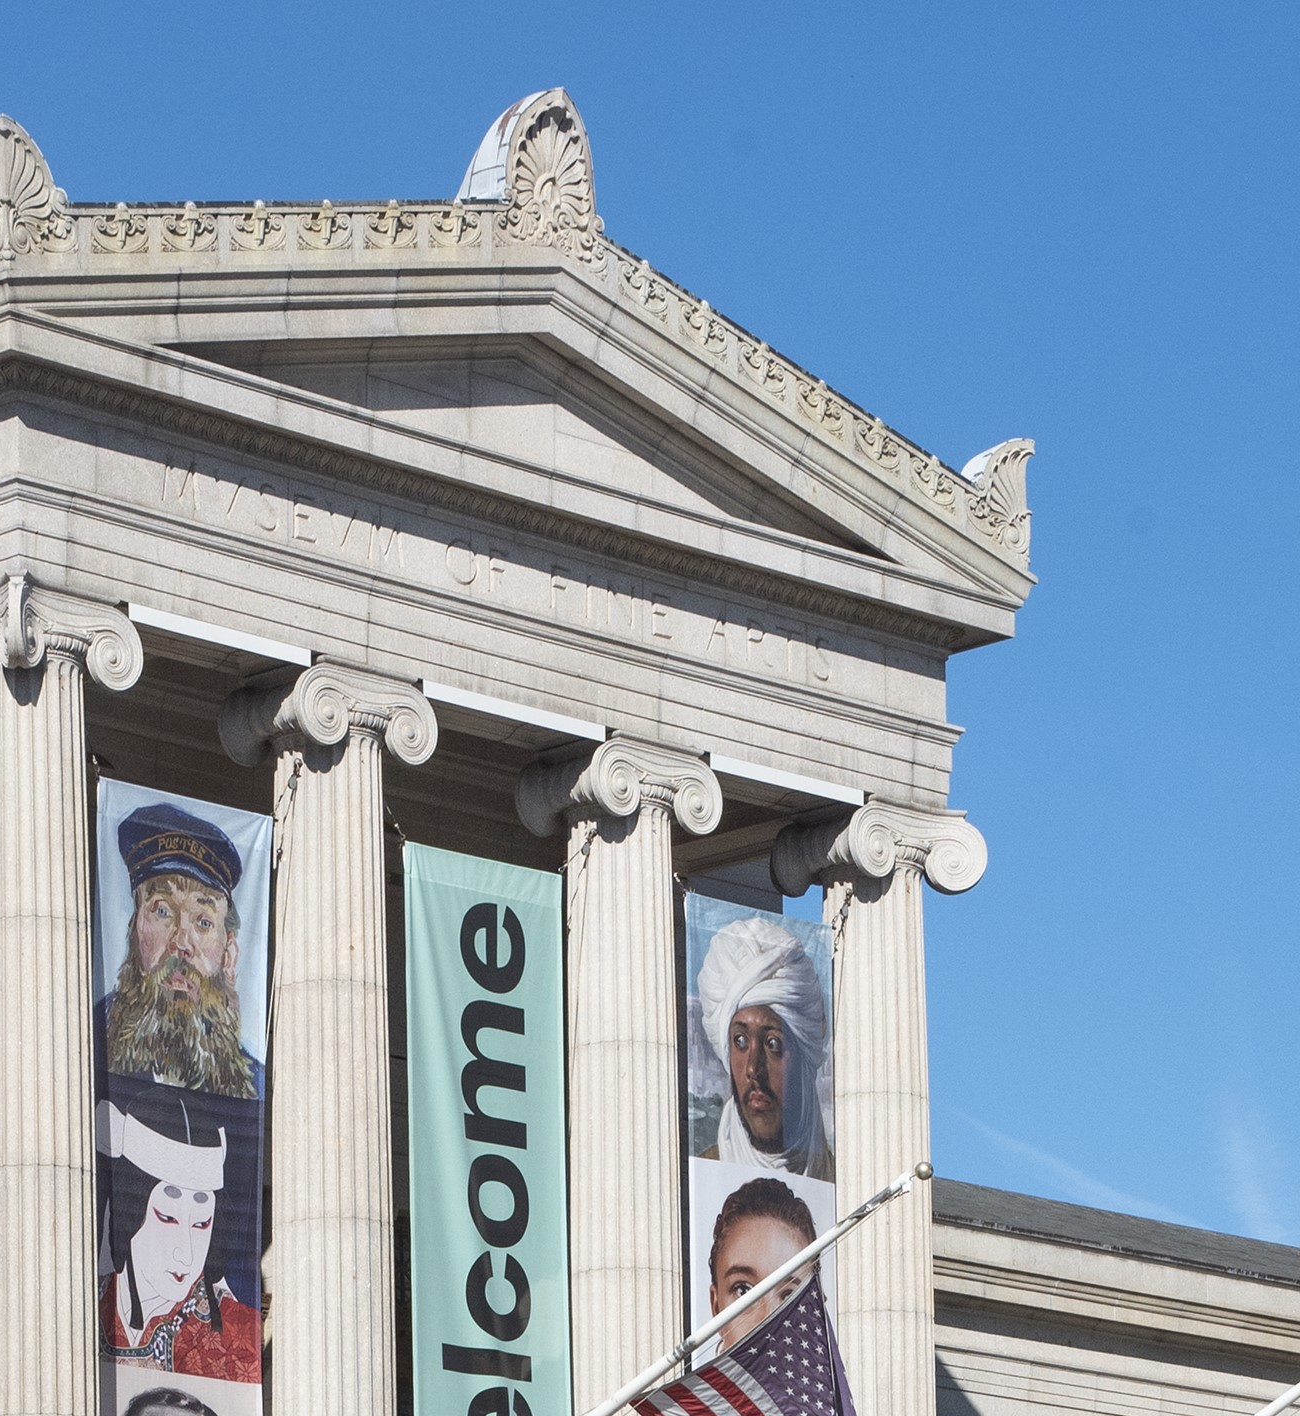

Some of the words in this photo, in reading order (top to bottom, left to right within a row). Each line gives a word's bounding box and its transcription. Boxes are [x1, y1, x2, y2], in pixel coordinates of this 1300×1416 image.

[445, 538, 508, 593] OF
[549, 565, 673, 640] FINE
[707, 610, 830, 682] ARTS
